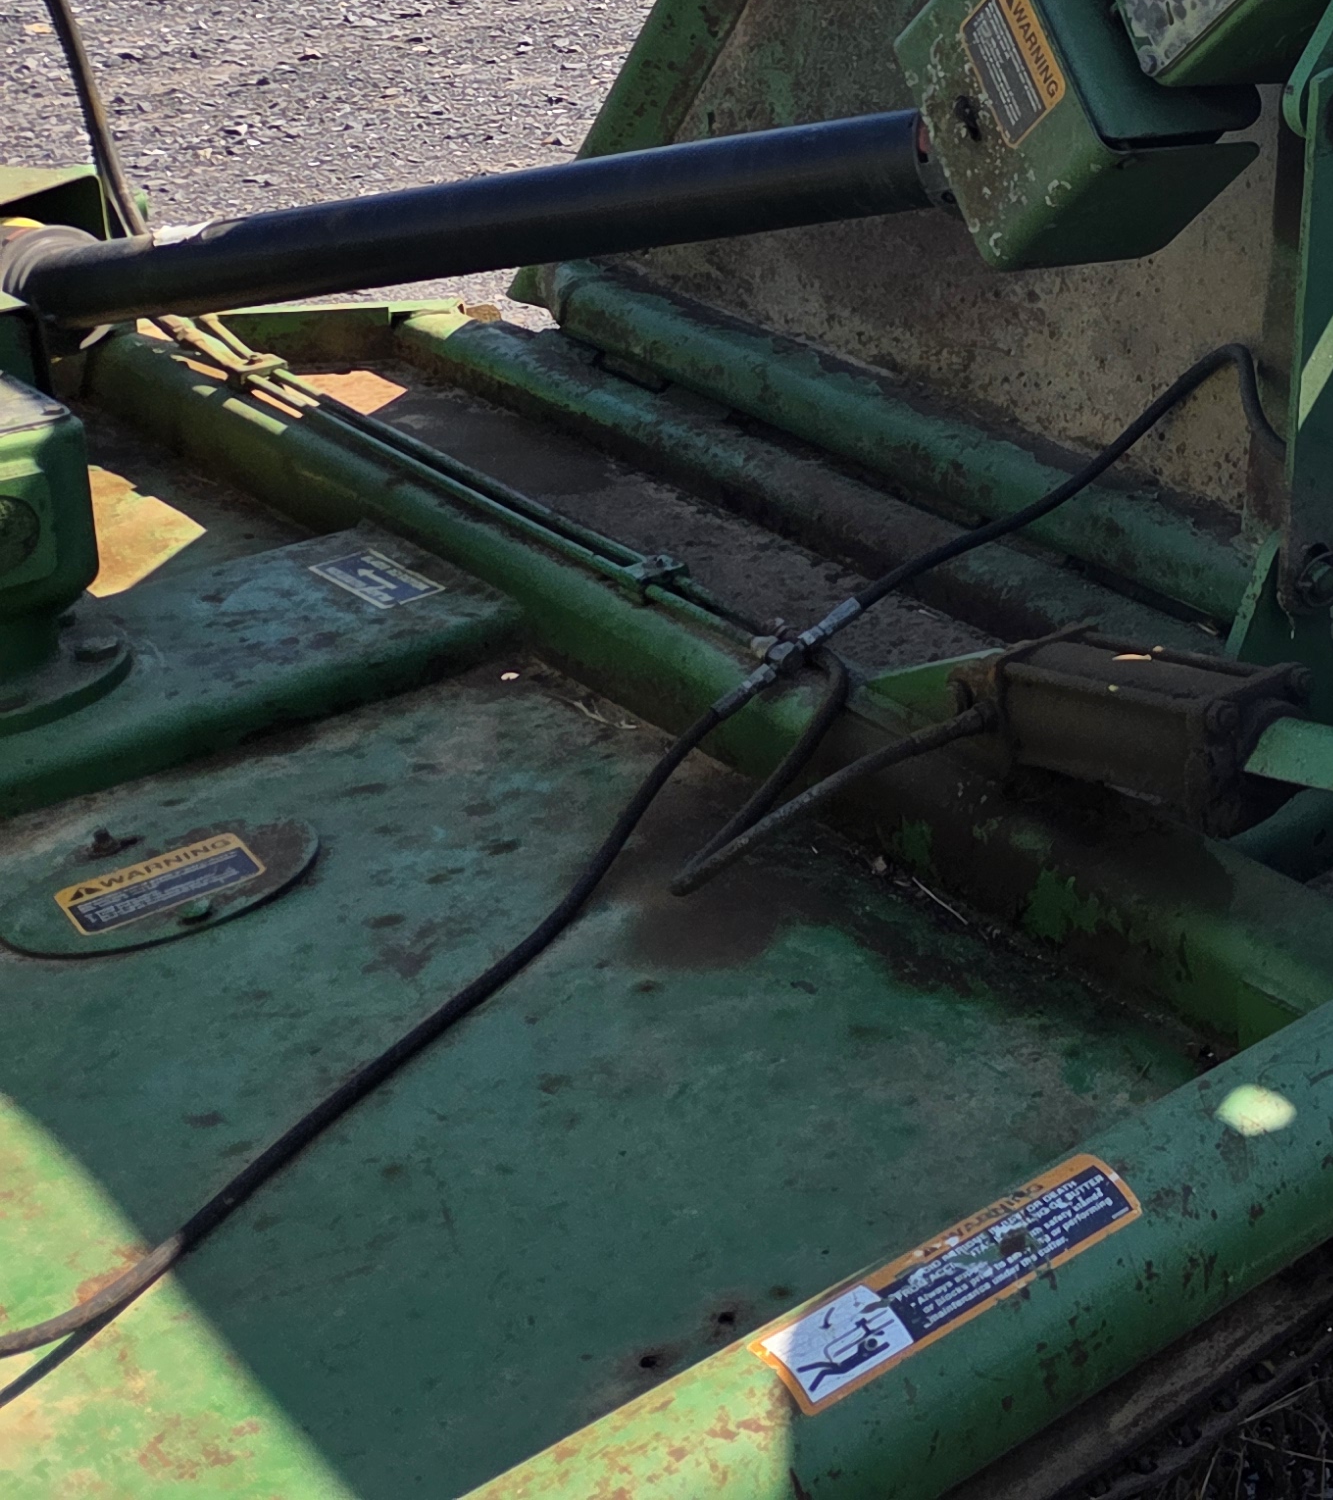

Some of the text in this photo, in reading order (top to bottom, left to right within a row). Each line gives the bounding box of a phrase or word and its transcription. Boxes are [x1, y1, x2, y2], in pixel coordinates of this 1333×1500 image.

[1012, 2, 1059, 99] WARNING
[98, 837, 232, 889] WARNING
[1025, 1198, 1043, 1213] OR
[1041, 1178, 1078, 1204] DEATH
[1060, 1195, 1115, 1232] performing
